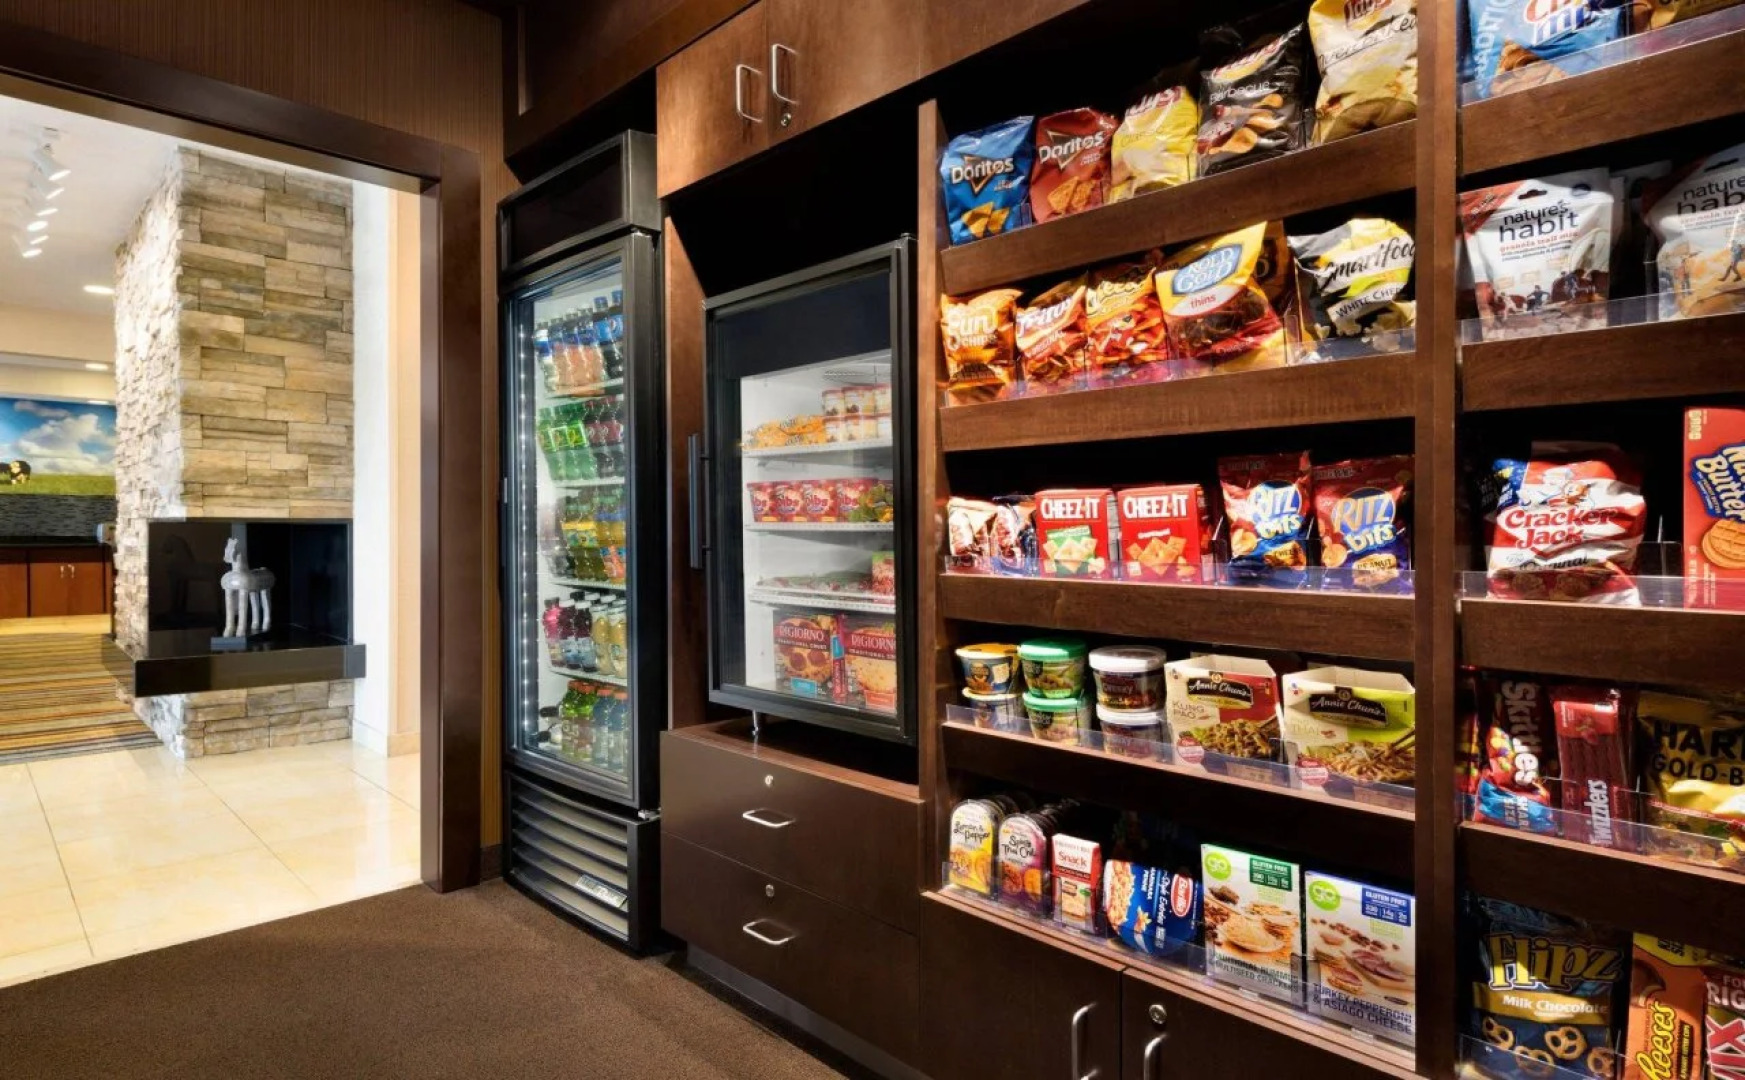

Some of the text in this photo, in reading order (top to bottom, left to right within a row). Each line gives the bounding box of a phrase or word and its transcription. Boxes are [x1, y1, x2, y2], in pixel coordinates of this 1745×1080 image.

[1038, 131, 1104, 164] Doritos
[951, 156, 1015, 184] Doritos
[1499, 211, 1579, 243] habit
[1190, 294, 1217, 307] thins
[1335, 295, 1374, 318] WHITE
[1695, 455, 1745, 522] Butter
[1334, 493, 1393, 534] RITZ
[1504, 508, 1611, 529] Cracker
[1345, 523, 1395, 552] bits
[1515, 526, 1584, 549] Jack
[1519, 552, 1588, 572] Oinal
[1189, 680, 1218, 692] Annie
[1312, 697, 1345, 709] Annie
[1501, 681, 1541, 785] Skittles
[1058, 850, 1088, 867] Snack
[1206, 857, 1228, 872] go
[1312, 885, 1335, 903] go
[1489, 933, 1622, 990] Flipz
[1313, 982, 1412, 1023] TURKEY PEPPERONI
[1503, 994, 1533, 1009] Milk
[1536, 999, 1609, 1014] Chocolate
[1324, 999, 1364, 1019] ASIAGO
[1367, 1011, 1413, 1036] CHEESE
[1636, 1000, 1677, 1080] Reese's
